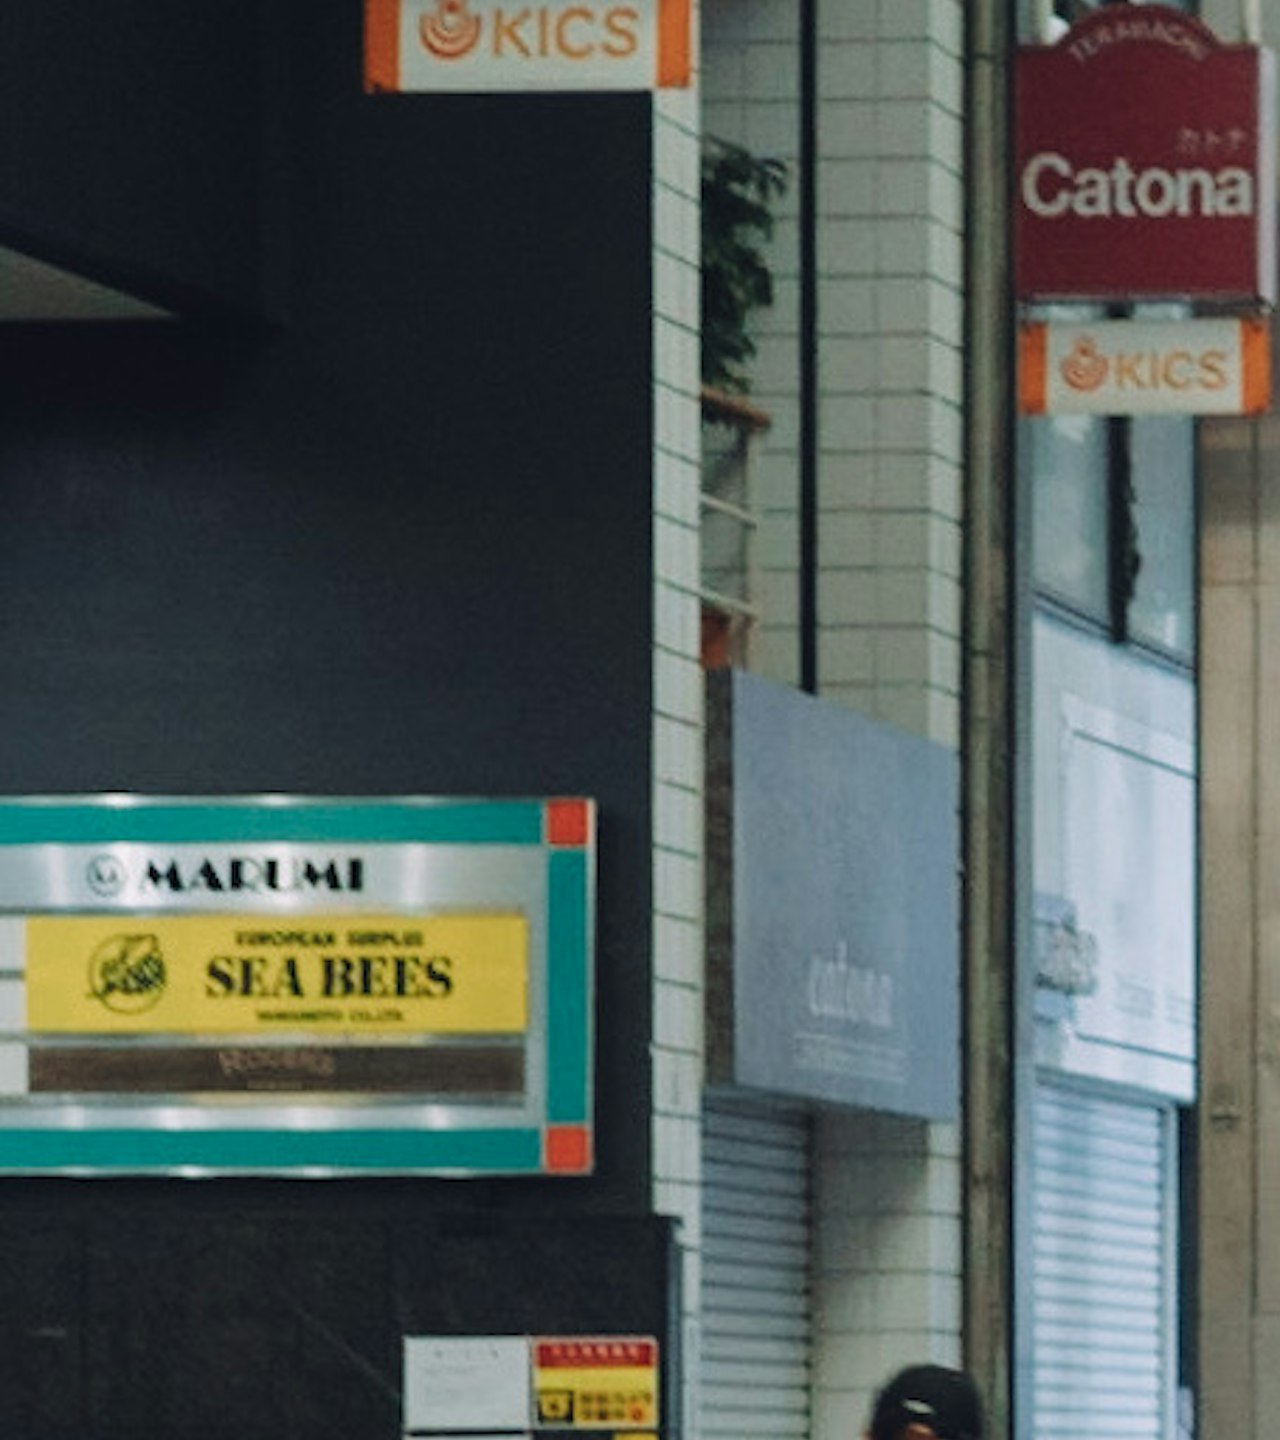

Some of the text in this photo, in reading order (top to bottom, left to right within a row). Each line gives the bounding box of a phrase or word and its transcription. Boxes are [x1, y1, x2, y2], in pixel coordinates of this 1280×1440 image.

[492, 7, 638, 58] KICS
[1022, 151, 1253, 217] Catona
[1115, 350, 1227, 391] KICS
[140, 858, 364, 892] MARUMI
[205, 957, 454, 999] SEA BEES
